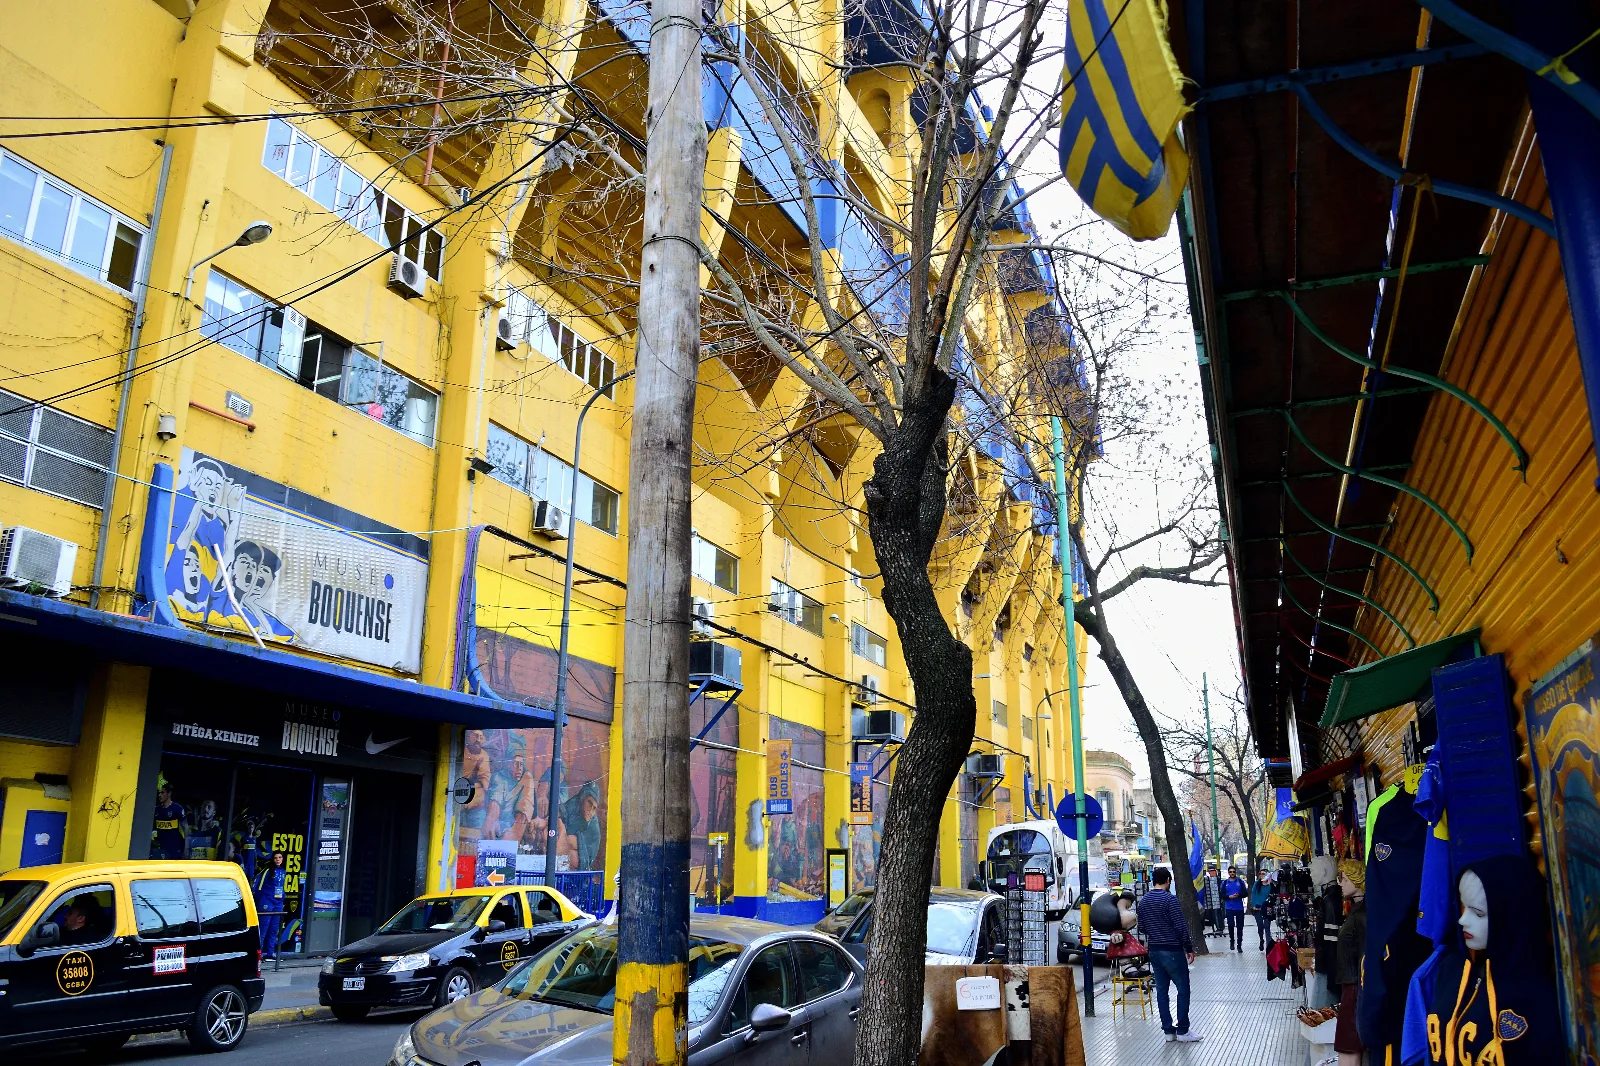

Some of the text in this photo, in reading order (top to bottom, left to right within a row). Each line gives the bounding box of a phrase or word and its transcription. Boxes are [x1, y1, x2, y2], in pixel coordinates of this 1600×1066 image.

[313, 550, 394, 590] MUSEO
[308, 580, 393, 643] BOQUENSE
[284, 701, 341, 721] MUSEO
[213, 729, 260, 747] XENEIZE
[281, 721, 340, 757] BOQUENSE
[769, 776, 778, 798] LOS
[780, 762, 789, 797] GOLES
[852, 797, 861, 812] LA
[271, 833, 304, 853] ESTO
[285, 854, 302, 873] ES
[283, 874, 299, 893] CA
[65, 957, 86, 965] TAXI
[156, 952, 183, 960] PREMIUM
[62, 967, 89, 980] 35808
[65, 981, 86, 989] GCBA
[1501, 1016, 1522, 1032] CABJ
